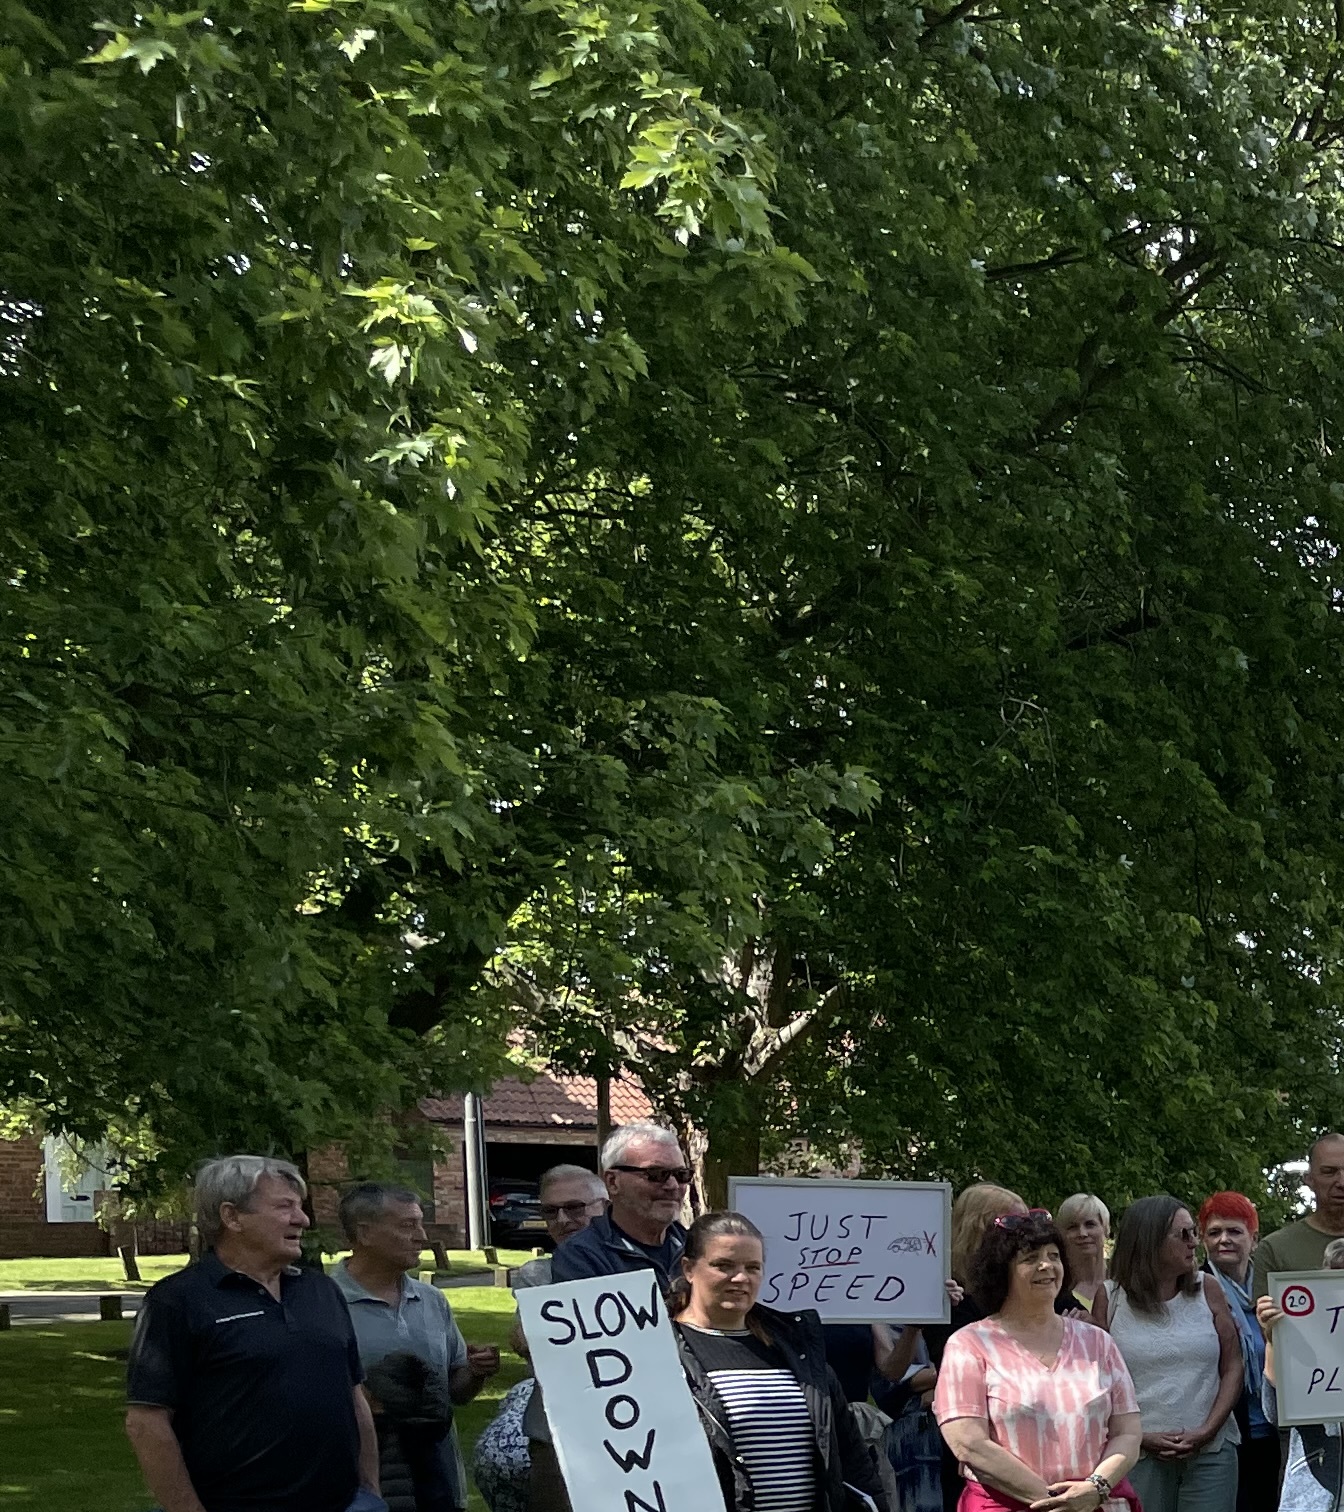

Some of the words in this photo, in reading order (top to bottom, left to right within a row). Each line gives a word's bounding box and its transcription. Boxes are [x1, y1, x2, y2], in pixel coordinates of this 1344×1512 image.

[784, 1211, 888, 1242] JUST
[799, 1246, 862, 1266] STOP
[763, 1274, 905, 1304] SPEED
[1289, 1294, 1307, 1308] 20
[540, 1281, 658, 1346] SLOW
